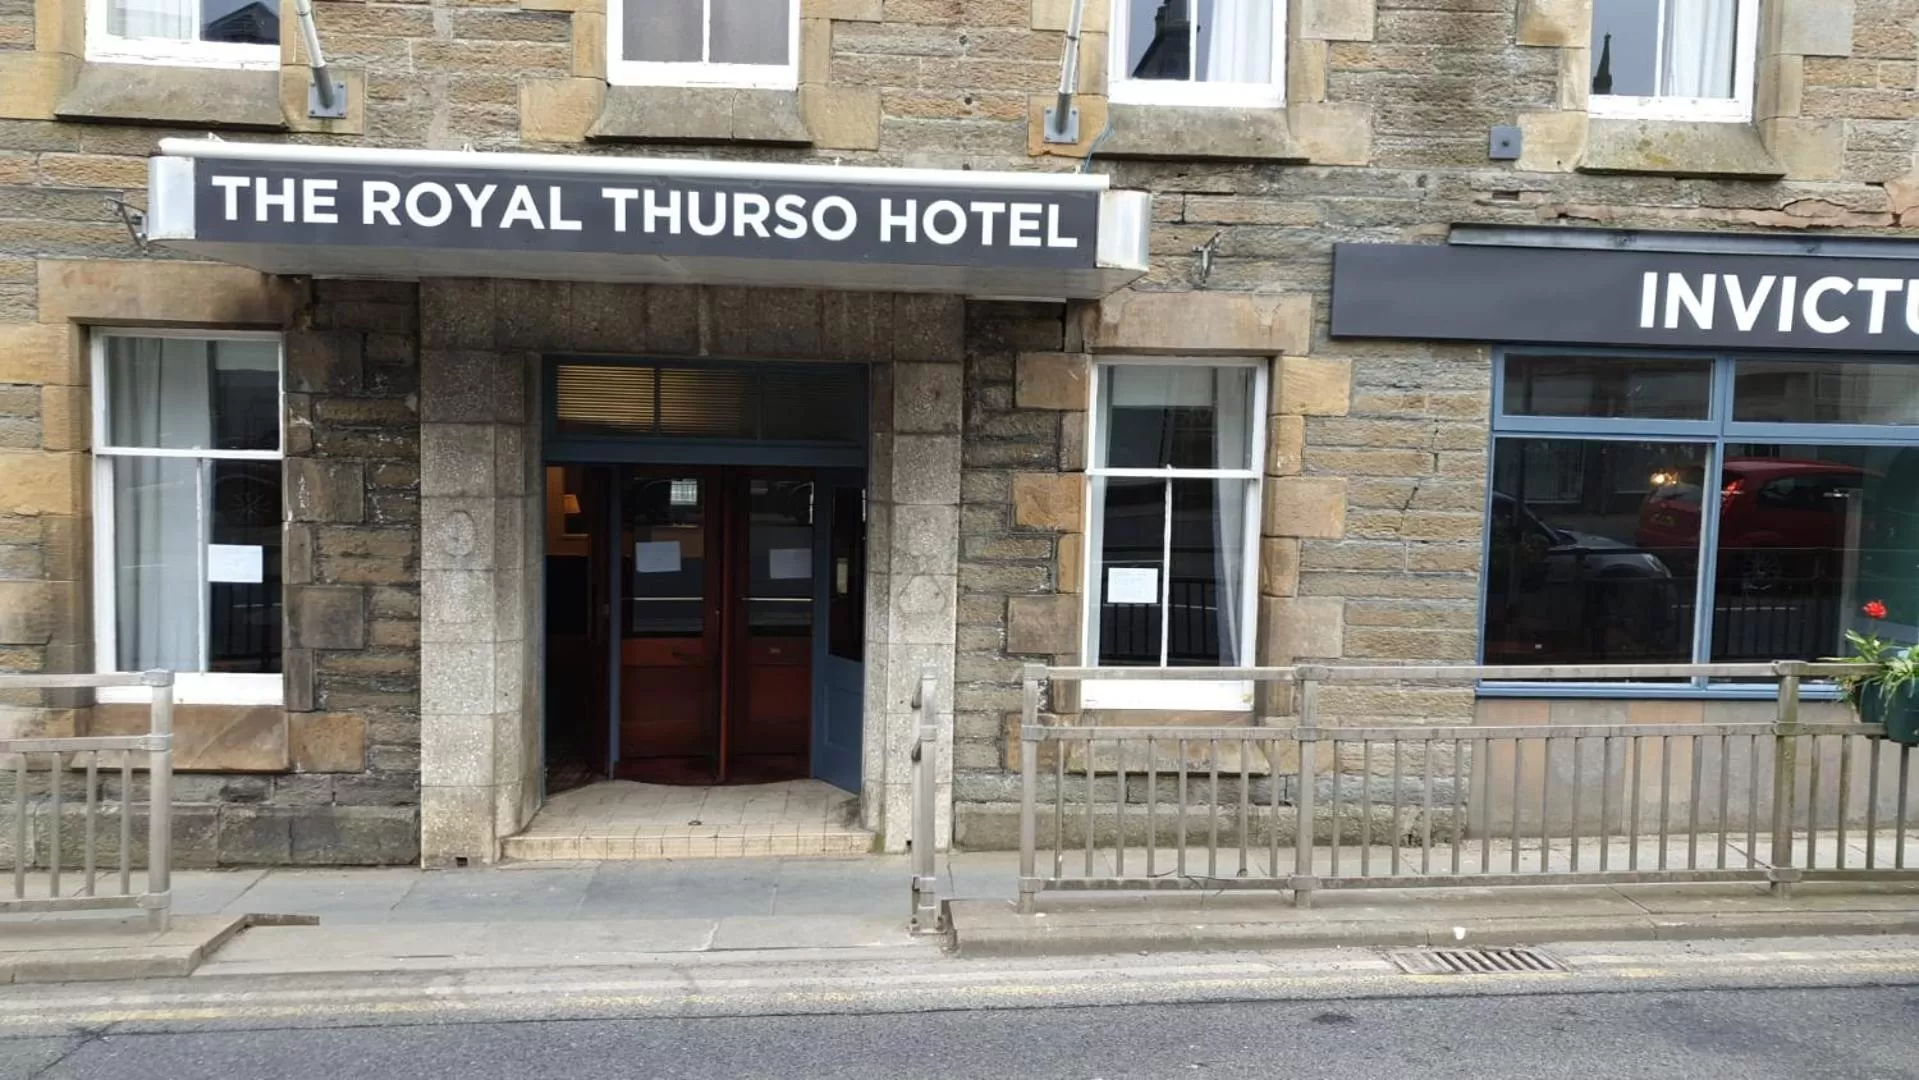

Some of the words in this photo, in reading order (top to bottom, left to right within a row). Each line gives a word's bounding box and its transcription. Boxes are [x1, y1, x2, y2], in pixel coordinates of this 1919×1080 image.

[211, 175, 339, 224] THE
[362, 180, 583, 231] ROYAL
[601, 187, 858, 241] THURSO
[880, 198, 1078, 248] HOTEL
